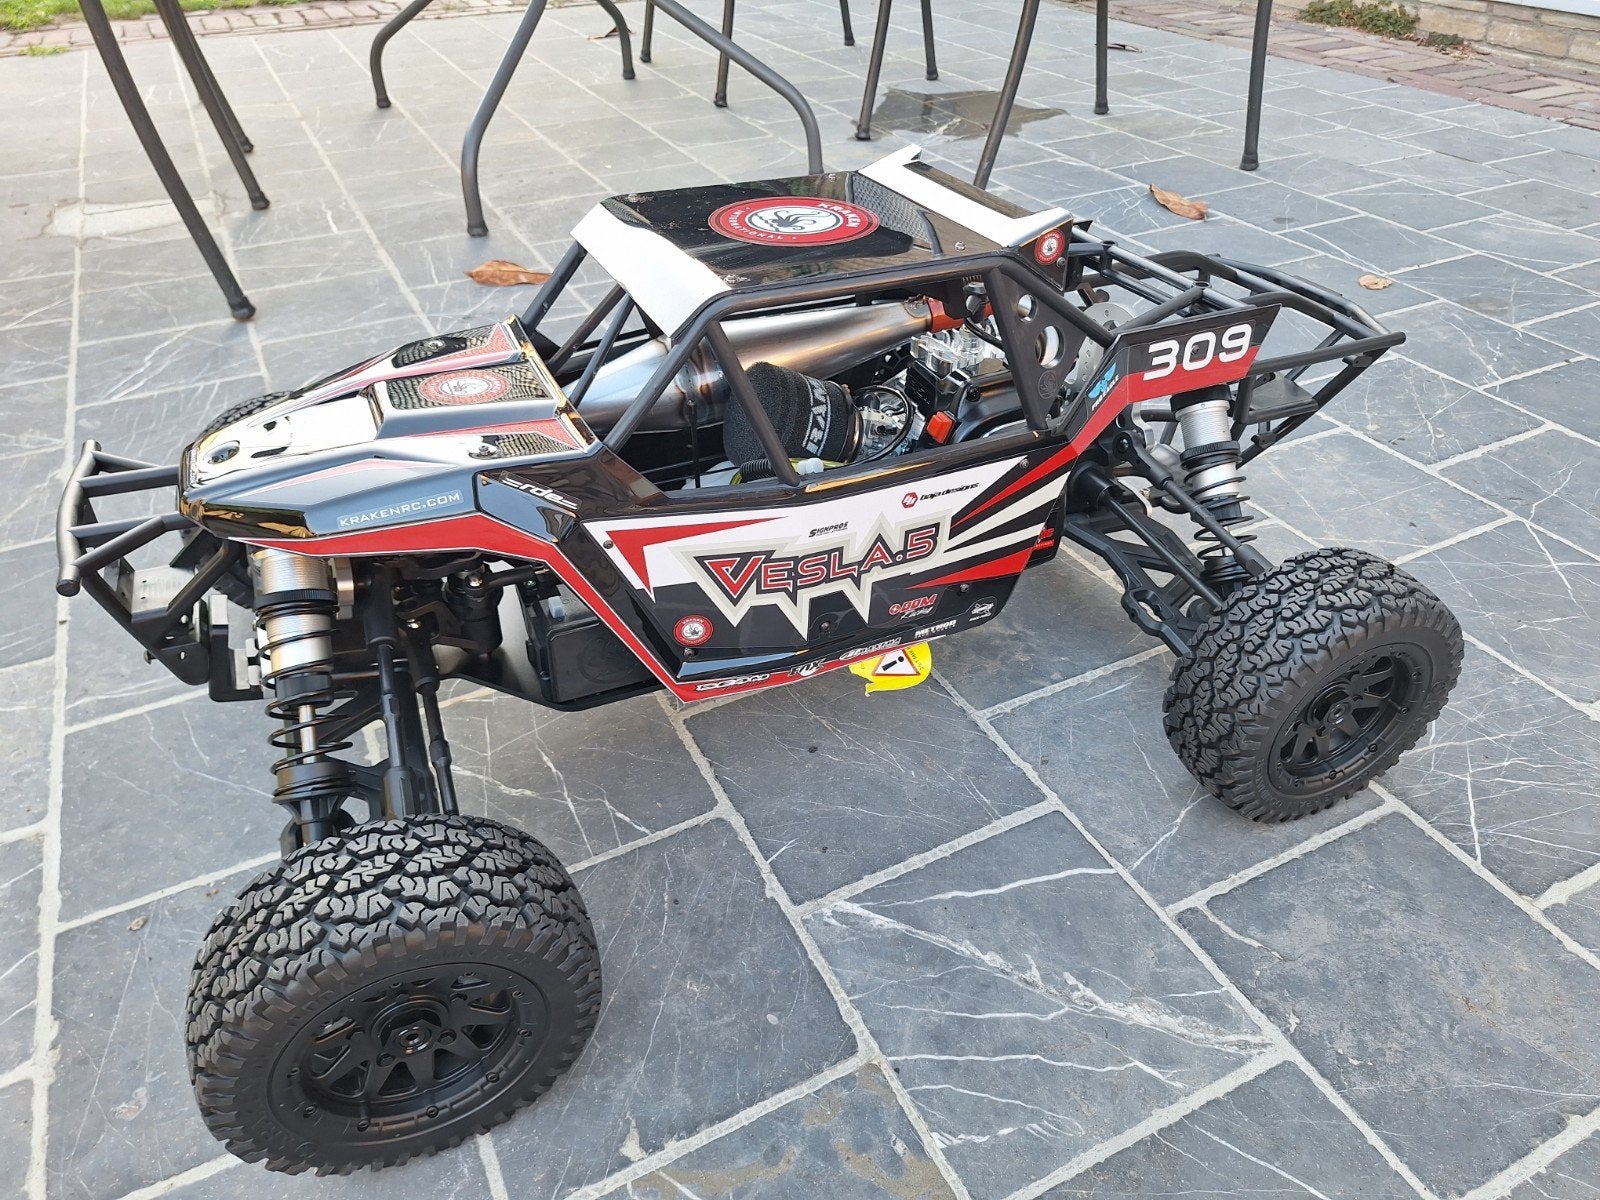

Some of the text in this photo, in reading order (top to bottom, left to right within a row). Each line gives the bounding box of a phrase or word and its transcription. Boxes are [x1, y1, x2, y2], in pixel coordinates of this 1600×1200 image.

[817, 202, 862, 228] KRAKEN
[1143, 323, 1252, 381] 309
[339, 492, 461, 528] KRAKENRC.COM
[704, 526, 937, 599] VESLA.5
